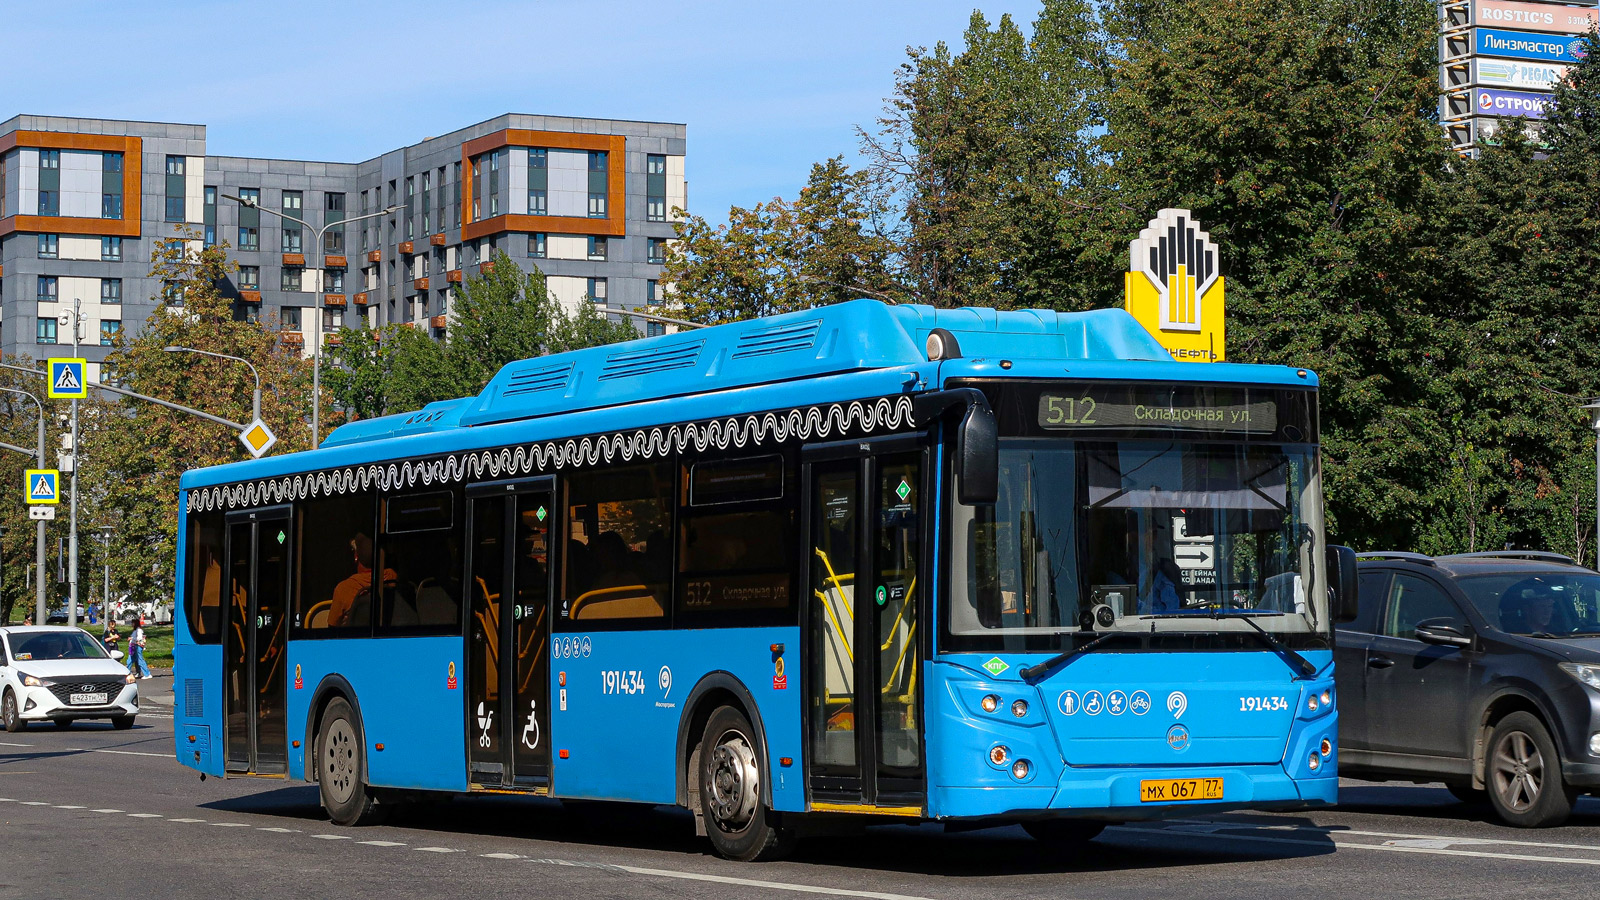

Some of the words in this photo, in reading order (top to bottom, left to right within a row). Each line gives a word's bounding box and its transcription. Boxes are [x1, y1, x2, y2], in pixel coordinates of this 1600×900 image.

[1482, 8, 1554, 25] ROSTIC'S
[1567, 16, 1572, 24] 3
[1484, 34, 1564, 57] Линзмастер
[1521, 66, 1555, 83] PEGAS
[1494, 96, 1543, 112] СТРОЙ
[1165, 348, 1217, 360] НЕФТЬ
[1046, 396, 1097, 425] 512
[1134, 404, 1224, 422] Складочная
[1230, 408, 1252, 425] ул.
[1181, 569, 1216, 577] СЕЕЙНАЯ
[686, 581, 712, 606] 512
[722, 586, 771, 601] Складочная
[601, 670, 646, 695] 191434
[1239, 696, 1288, 711] 191434
[1147, 785, 1165, 799] МХ
[1171, 781, 1197, 797] 067
[1205, 779, 1219, 792] 77
